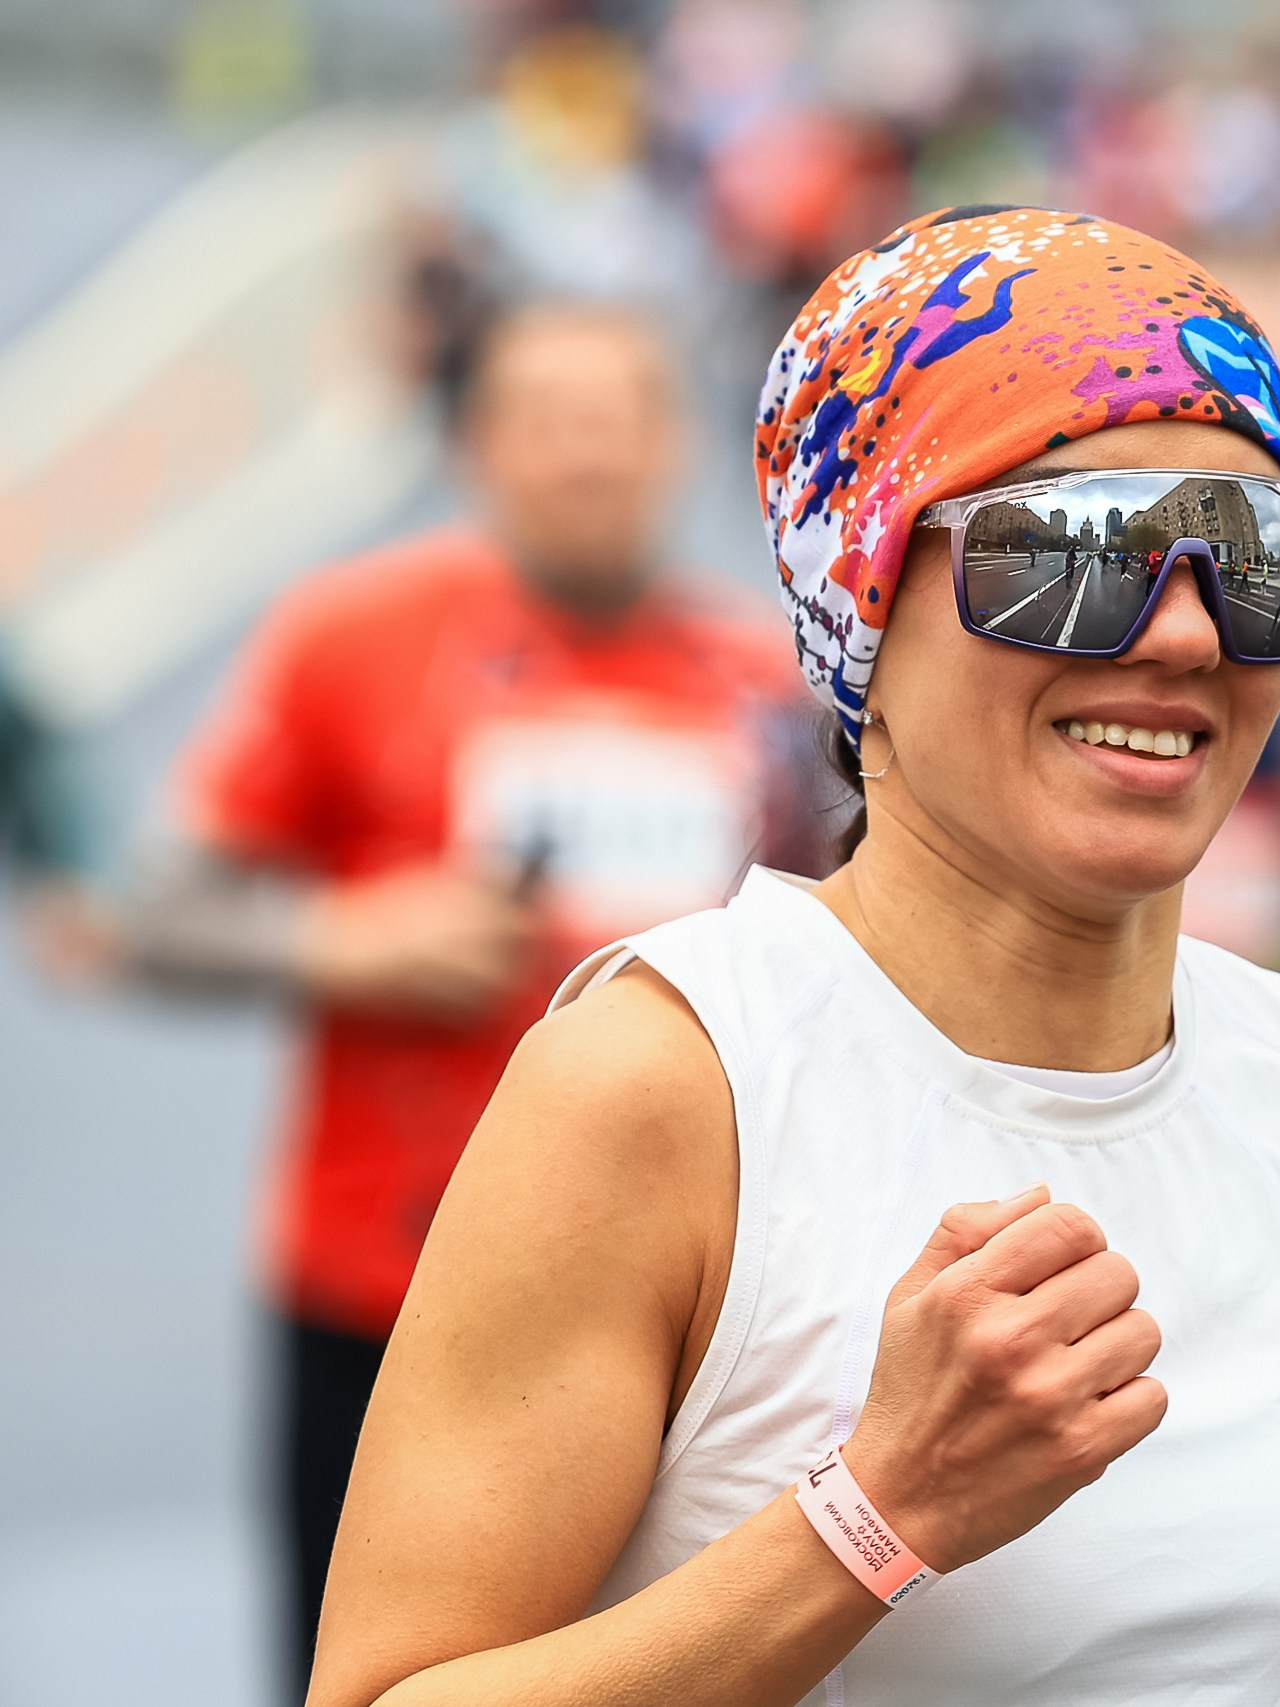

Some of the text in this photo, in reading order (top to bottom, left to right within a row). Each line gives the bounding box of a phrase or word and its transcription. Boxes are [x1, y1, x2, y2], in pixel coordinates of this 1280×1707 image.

[808, 1451, 837, 1489] 7
[855, 1503, 901, 1557] МАРАФОН
[863, 1535, 892, 1564] ПОЛУ
[890, 1573, 927, 1603] 020761
